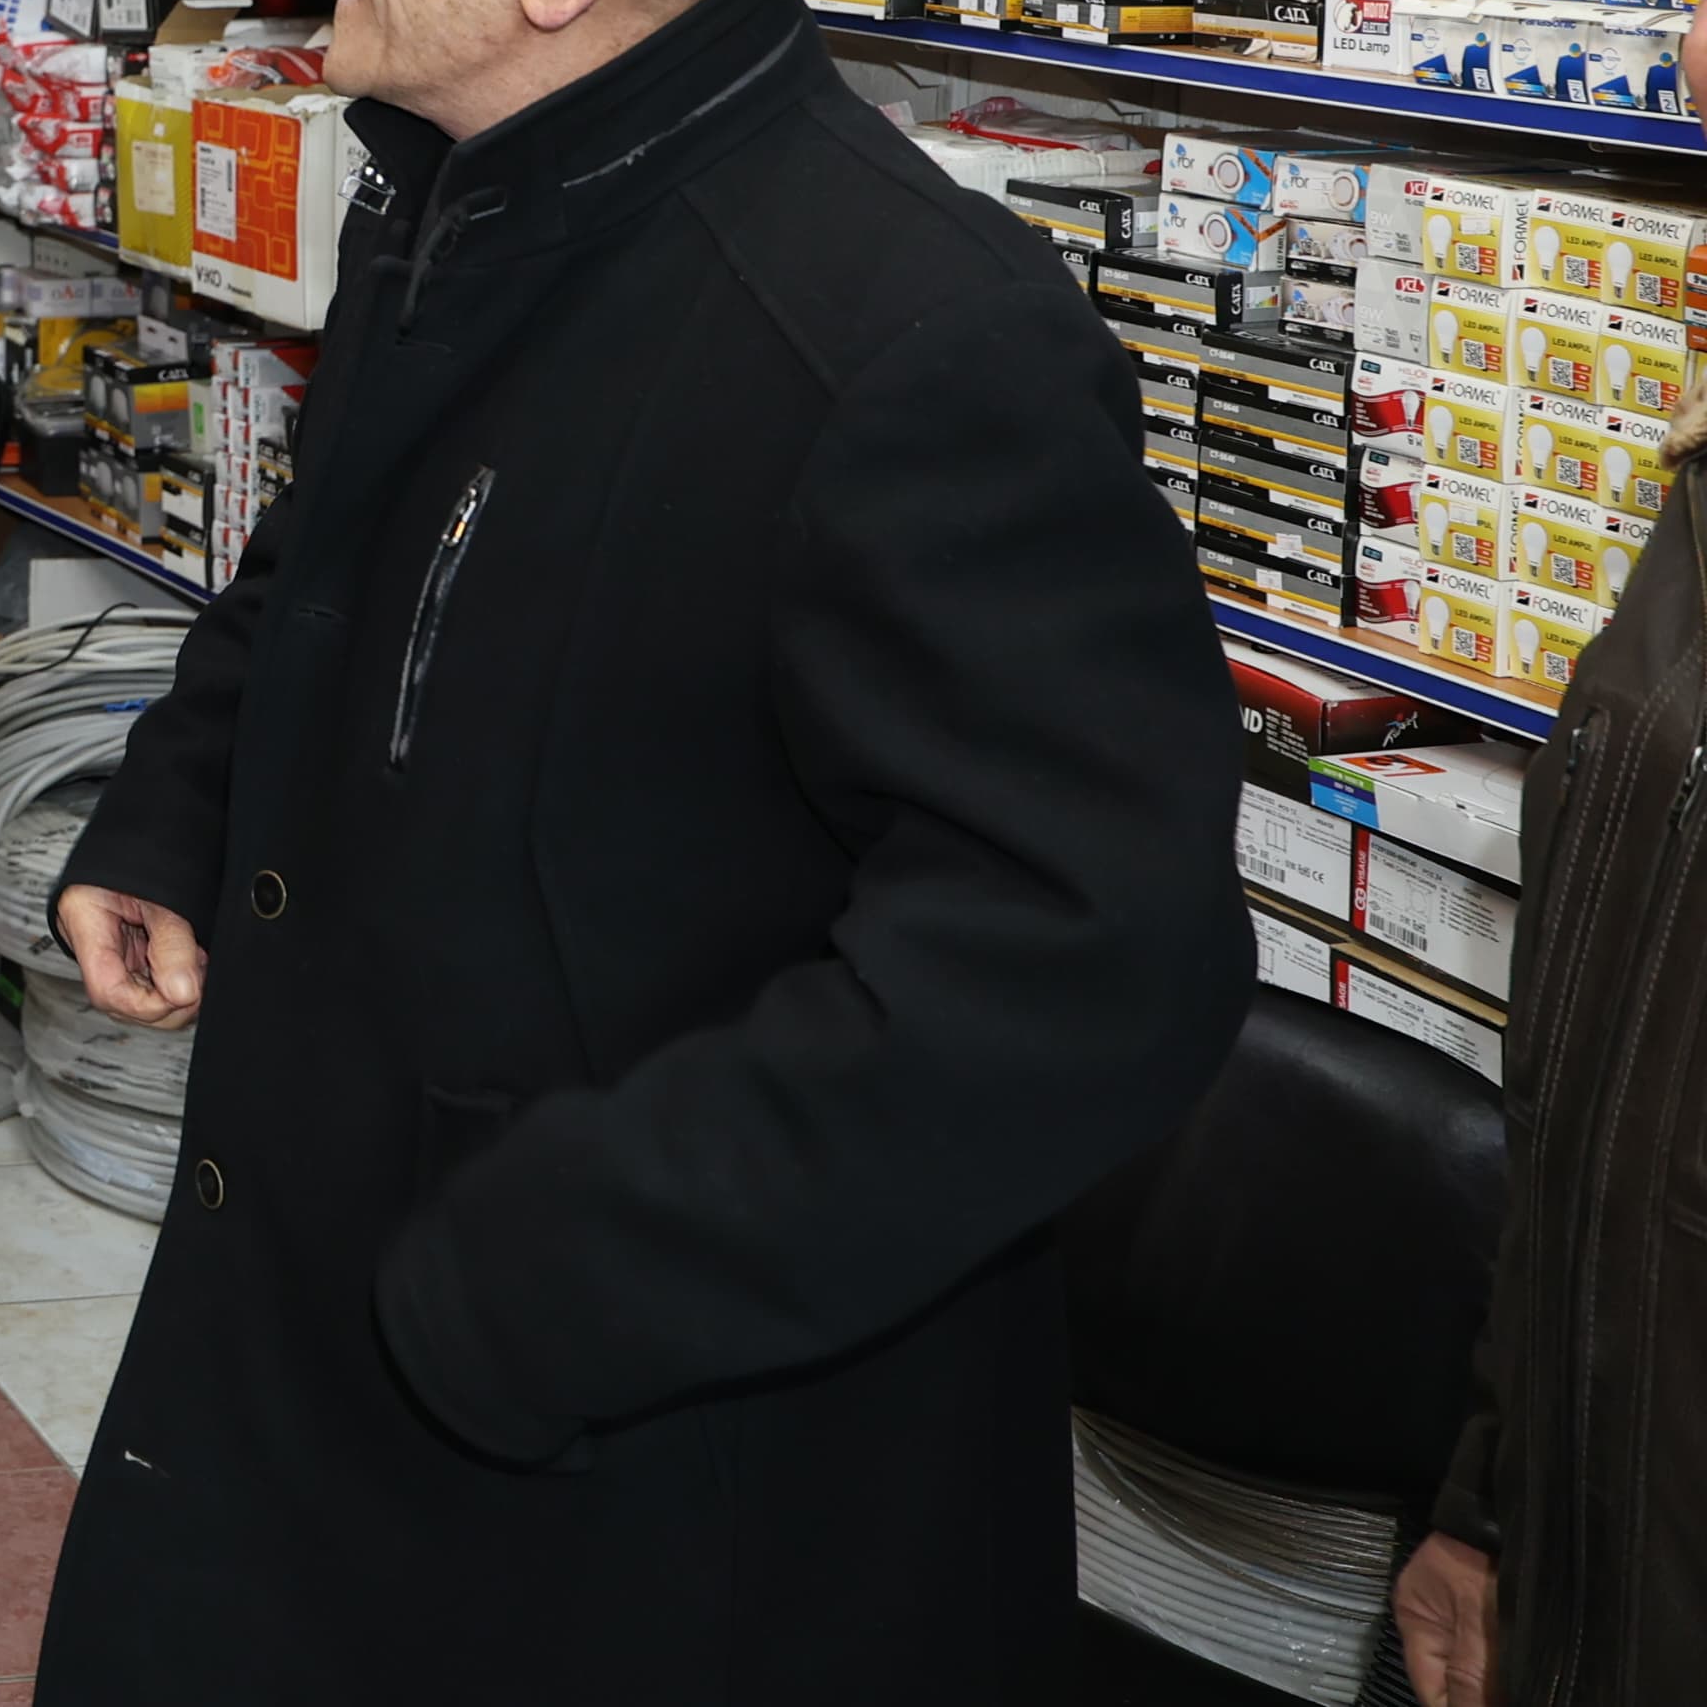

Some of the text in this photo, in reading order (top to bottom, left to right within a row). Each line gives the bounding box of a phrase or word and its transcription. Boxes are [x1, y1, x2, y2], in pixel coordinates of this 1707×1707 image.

[1275, 5, 1309, 23] CATA
[1334, 36, 1390, 54] LED Lamp
[1446, 189, 1495, 210] FORMEL
[1553, 201, 1605, 224] FORMEL
[1515, 201, 1528, 261] FORMEL
[1628, 216, 1680, 239] FORMEL
[1639, 252, 1679, 268] LED AMPUL
[1453, 286, 1501, 307] FORMEL
[1540, 302, 1593, 326] FORMEL
[1463, 320, 1500, 334] LED AMPUL
[1626, 320, 1680, 344] FORMEL
[1553, 338, 1591, 353] LED AMPUL
[1309, 358, 1336, 373] CATA
[1638, 356, 1679, 373] LED AMPUL
[1447, 382, 1497, 406] FORMEL
[1545, 400, 1598, 425] FORMEL
[1459, 417, 1497, 432] LED AMPUL
[1441, 479, 1491, 503] FORMEL
[1540, 500, 1592, 524] FORMEL
[1455, 609, 1491, 625] LED AMPUL
